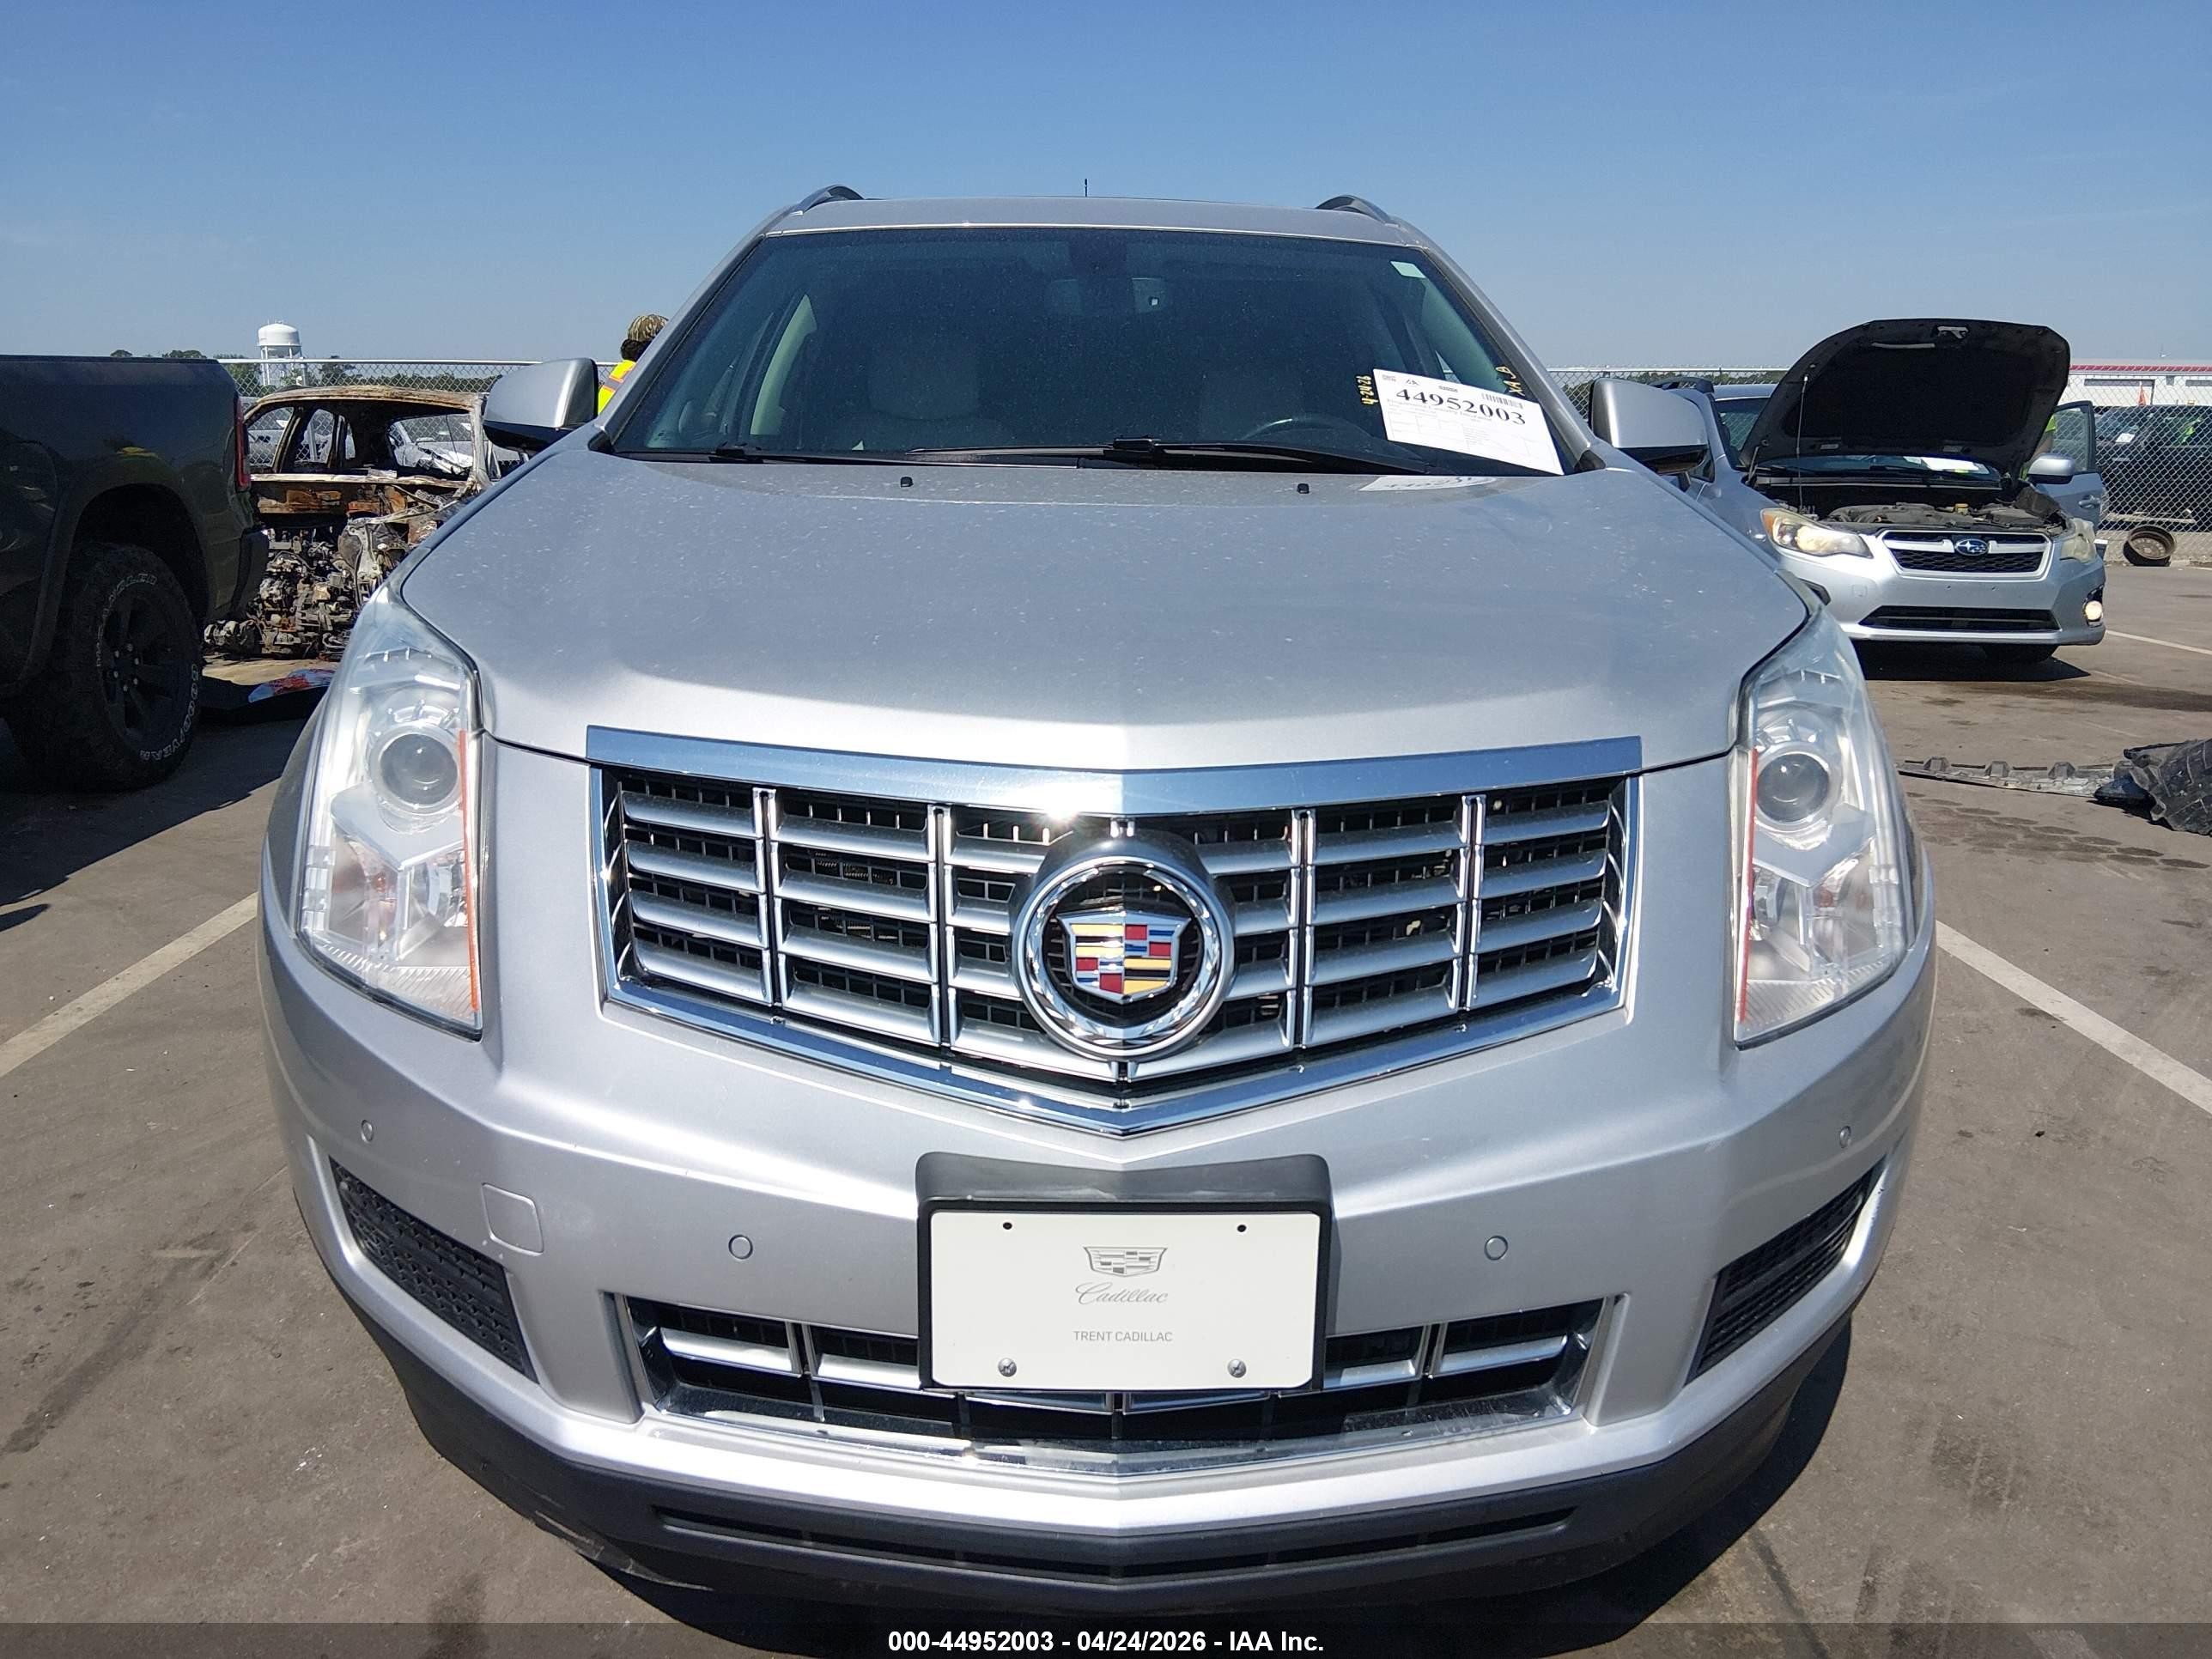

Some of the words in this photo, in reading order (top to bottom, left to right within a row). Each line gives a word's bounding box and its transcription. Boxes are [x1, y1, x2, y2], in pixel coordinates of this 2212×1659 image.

[1396, 389, 1525, 424] 44952003
[1075, 1281, 1169, 1305] Cadillac
[1073, 1331, 1113, 1341] TRENT
[1115, 1331, 1173, 1341] CADILLAC
